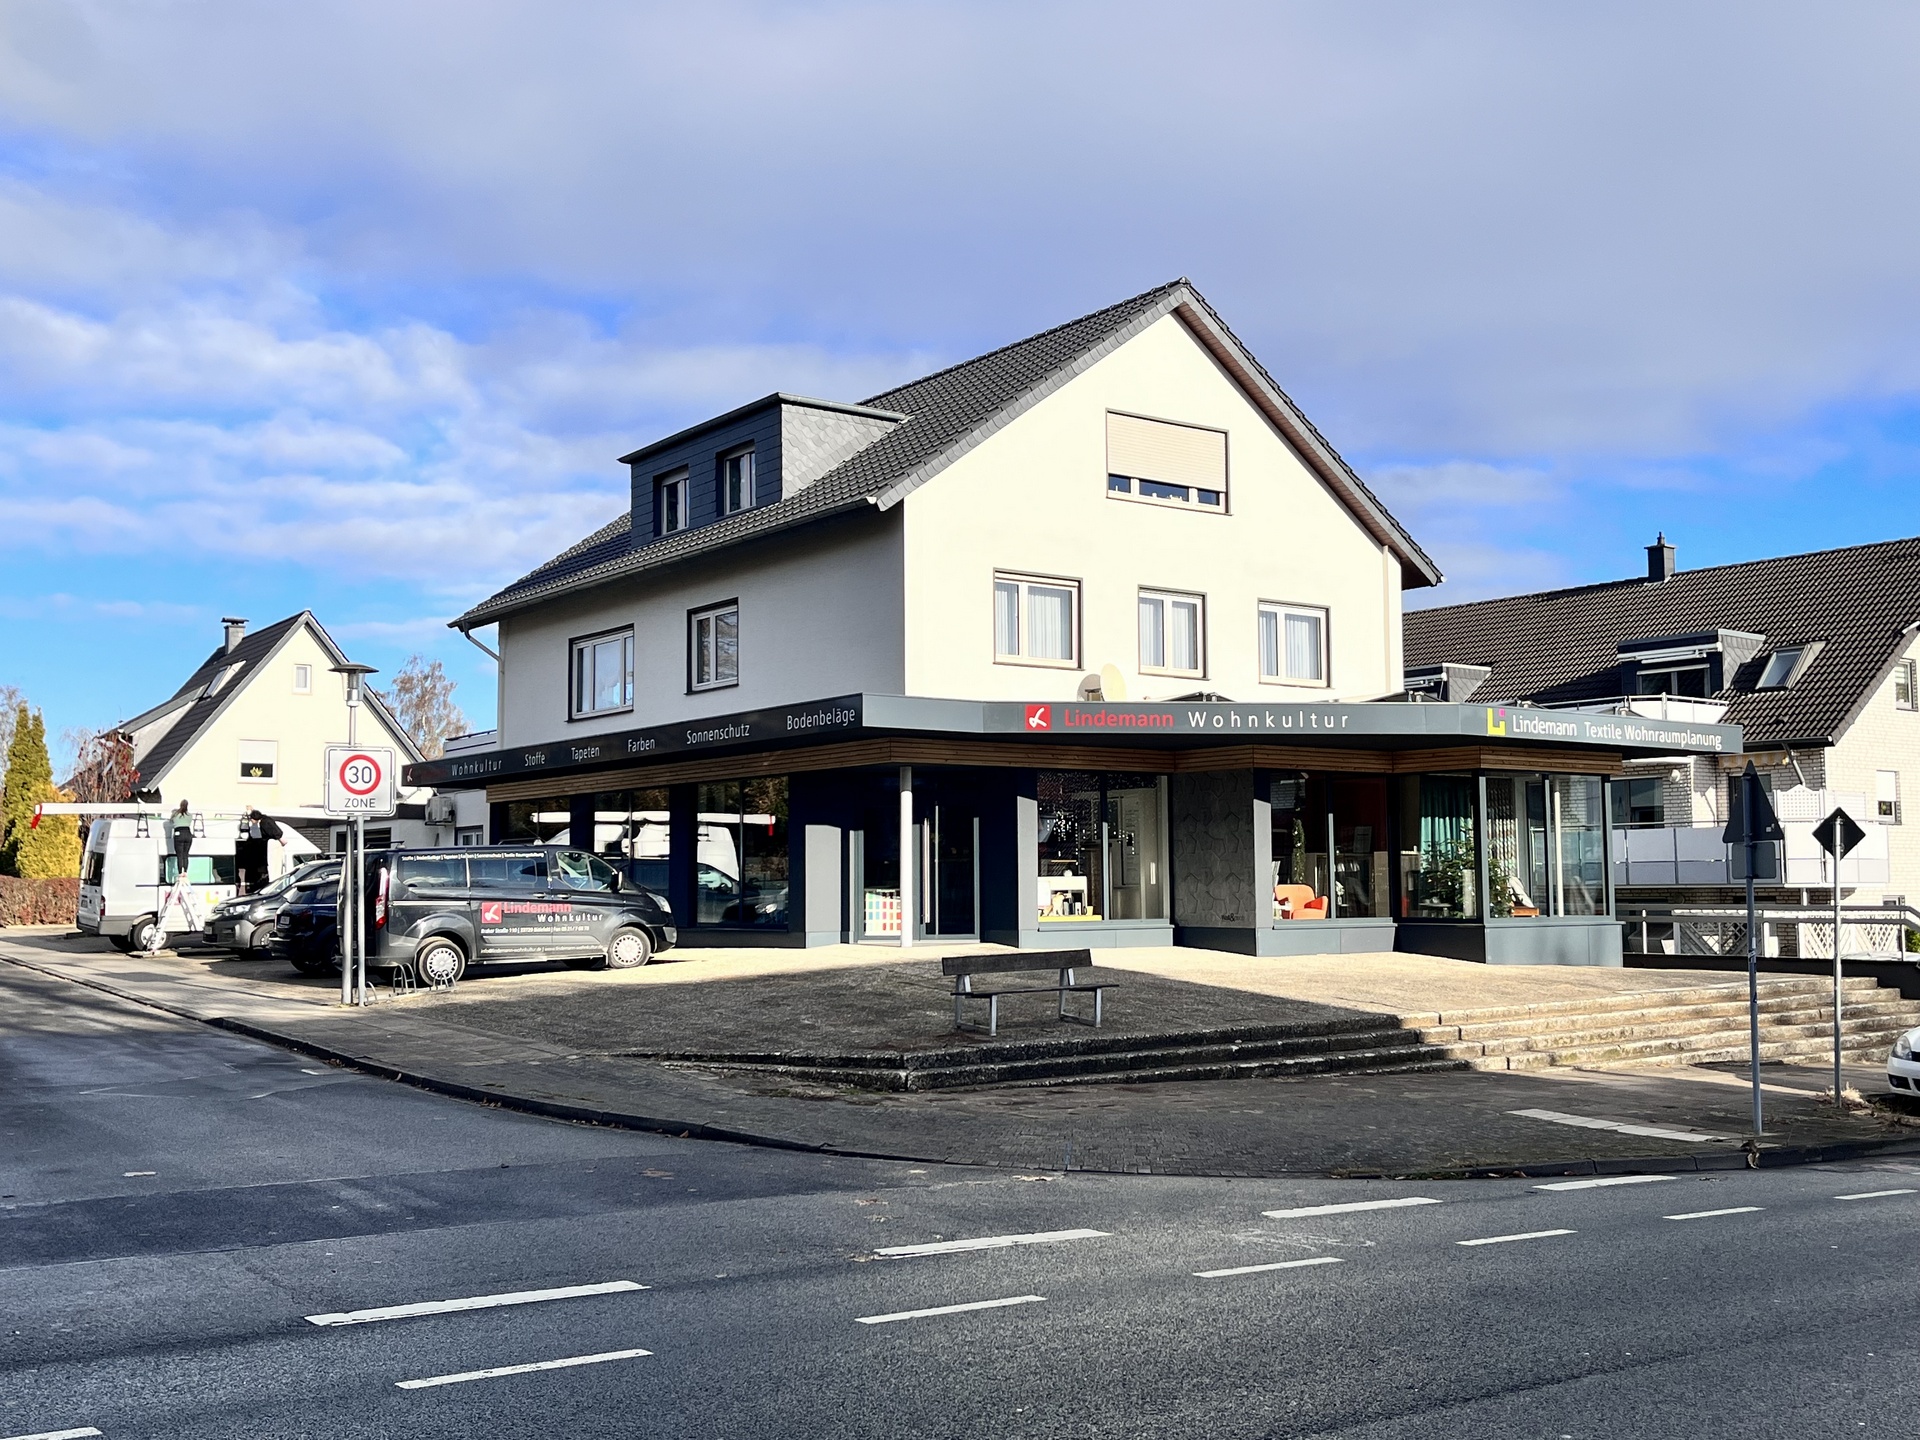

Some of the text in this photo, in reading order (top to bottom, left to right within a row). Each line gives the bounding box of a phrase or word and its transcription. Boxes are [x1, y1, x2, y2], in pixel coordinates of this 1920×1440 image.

[1064, 709, 1350, 729] Lindemann Wohnkultur
[1512, 715, 1722, 750] Lindemann Textile Wohnraumplanung
[451, 759, 502, 776] Wohnkultur
[524, 751, 546, 767] Stoffe
[571, 745, 600, 762] Tapeten
[628, 737, 655, 753] Farben
[686, 724, 750, 745] Sonnenschutz
[786, 708, 856, 731] Bodenbeläge
[348, 766, 373, 784] 30
[345, 798, 376, 808] ZONE
[504, 903, 572, 914] Lindemann
[537, 914, 603, 923] Wohnkultur
